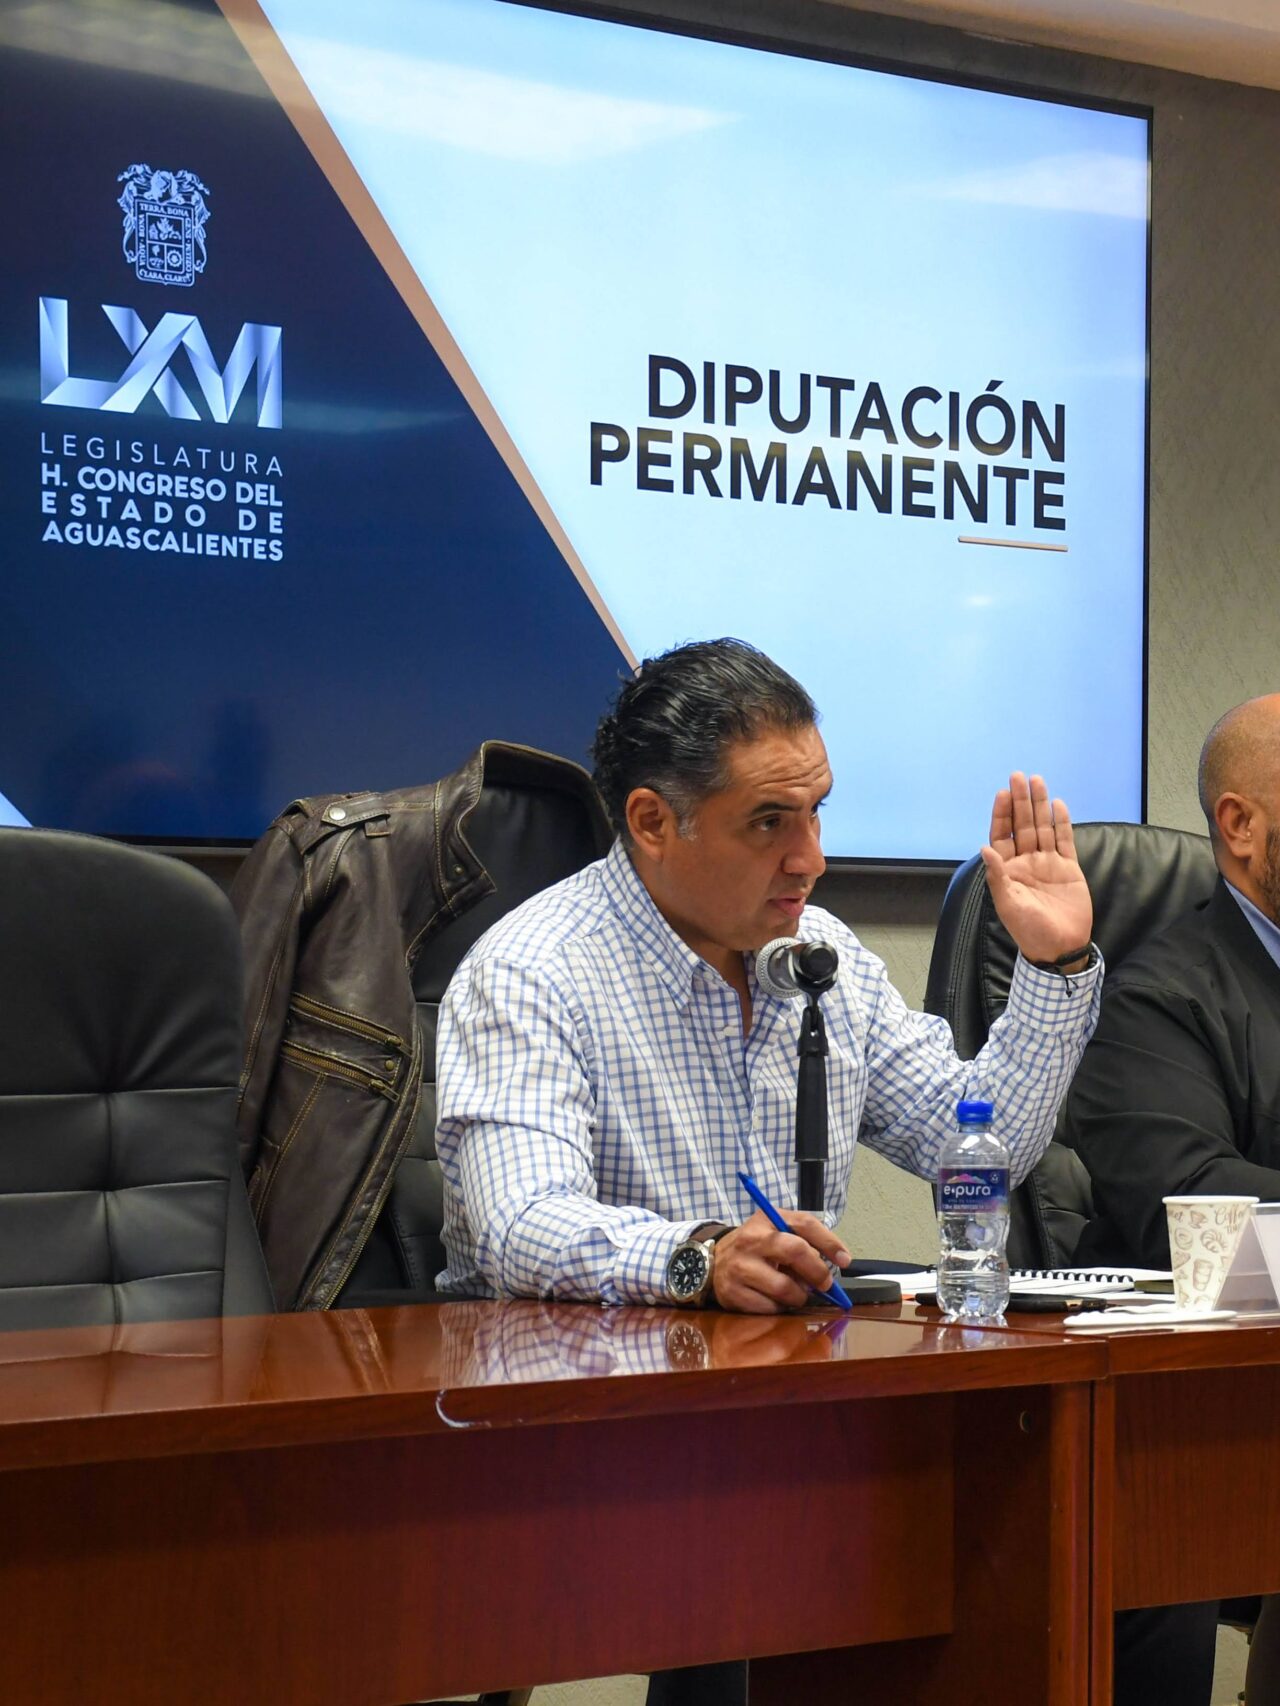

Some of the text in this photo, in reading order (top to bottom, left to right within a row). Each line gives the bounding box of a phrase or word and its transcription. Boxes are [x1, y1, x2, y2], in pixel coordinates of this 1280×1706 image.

[648, 354, 1066, 463] DIPUTACIÓN
[41, 432, 284, 477] LEGISLATURA
[590, 421, 1067, 531] PERMANENTE
[41, 462, 284, 507] H. CONGRESO DEL
[41, 491, 284, 535] ESTADO DE
[42, 520, 284, 562] AGUASCALIENTES
